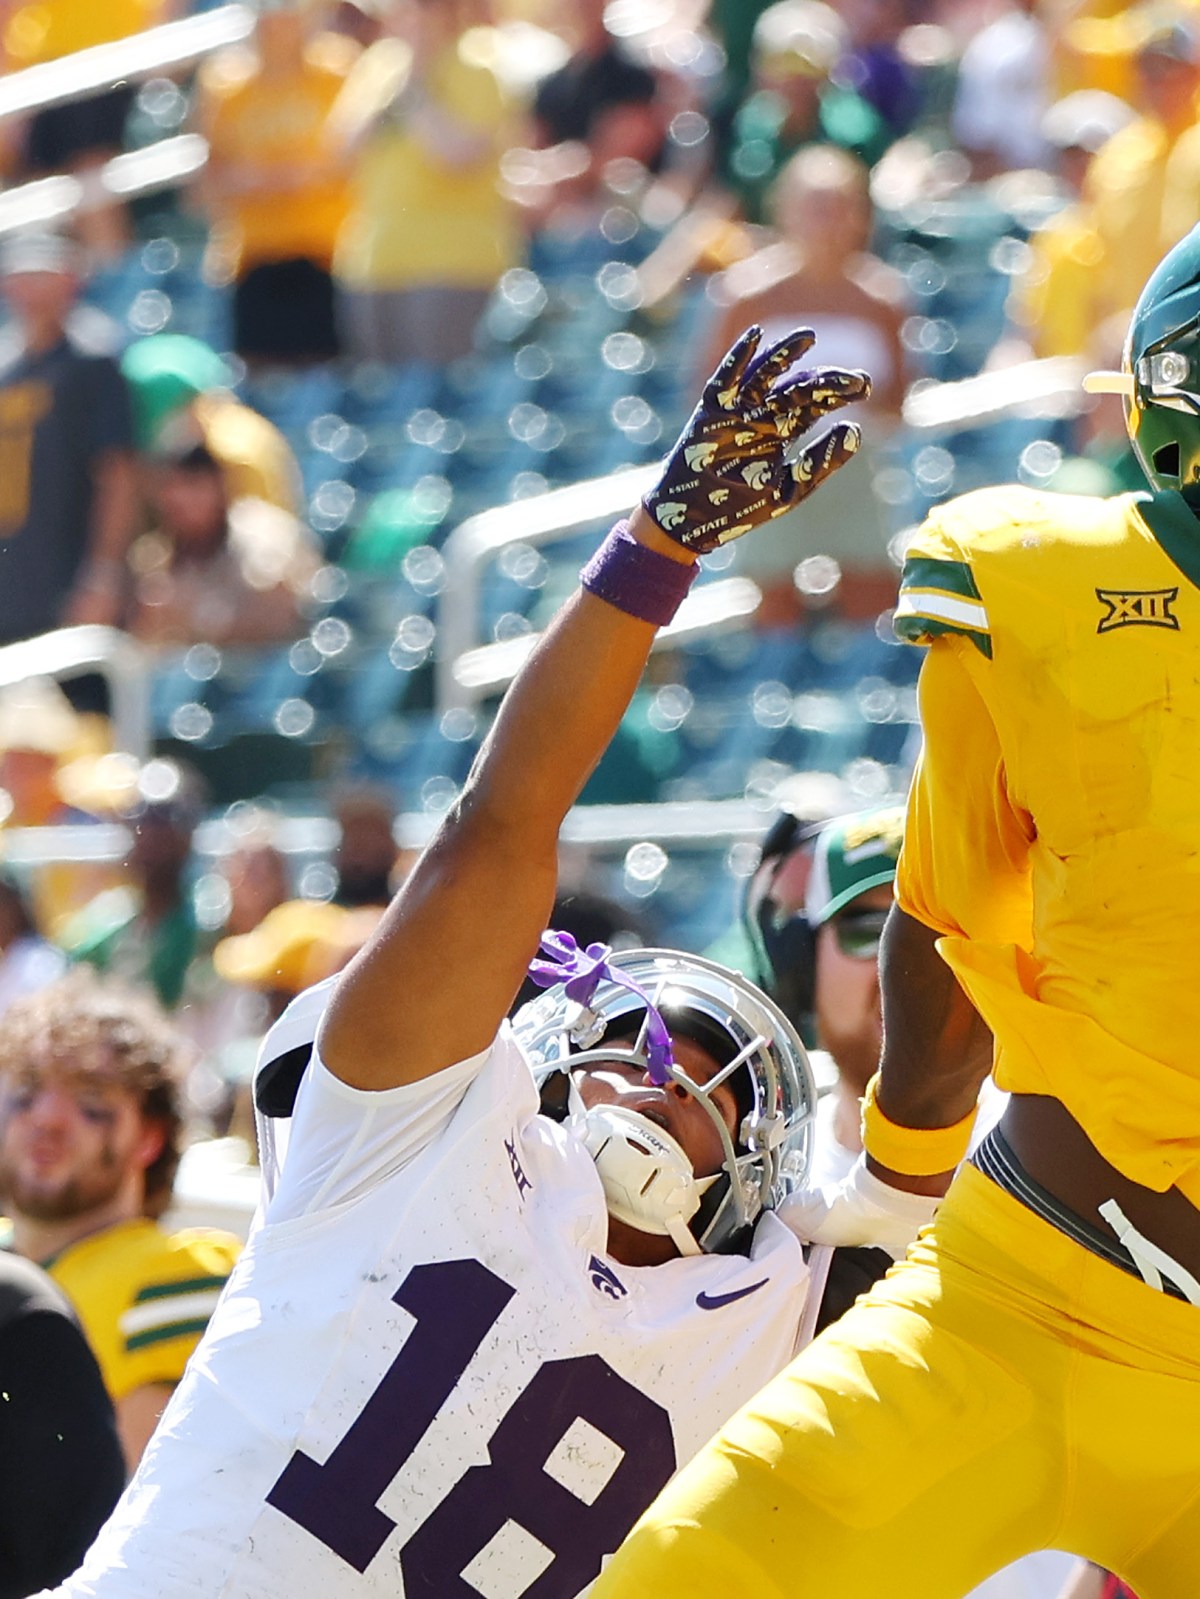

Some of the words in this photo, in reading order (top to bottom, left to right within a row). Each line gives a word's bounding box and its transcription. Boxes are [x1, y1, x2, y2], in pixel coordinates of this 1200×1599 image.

[716, 457, 741, 477] K-STATE
[669, 479, 700, 495] K-STATE
[735, 499, 767, 519] K-STATE
[682, 516, 728, 543] K-STATE
[265, 1258, 676, 1599] 18
